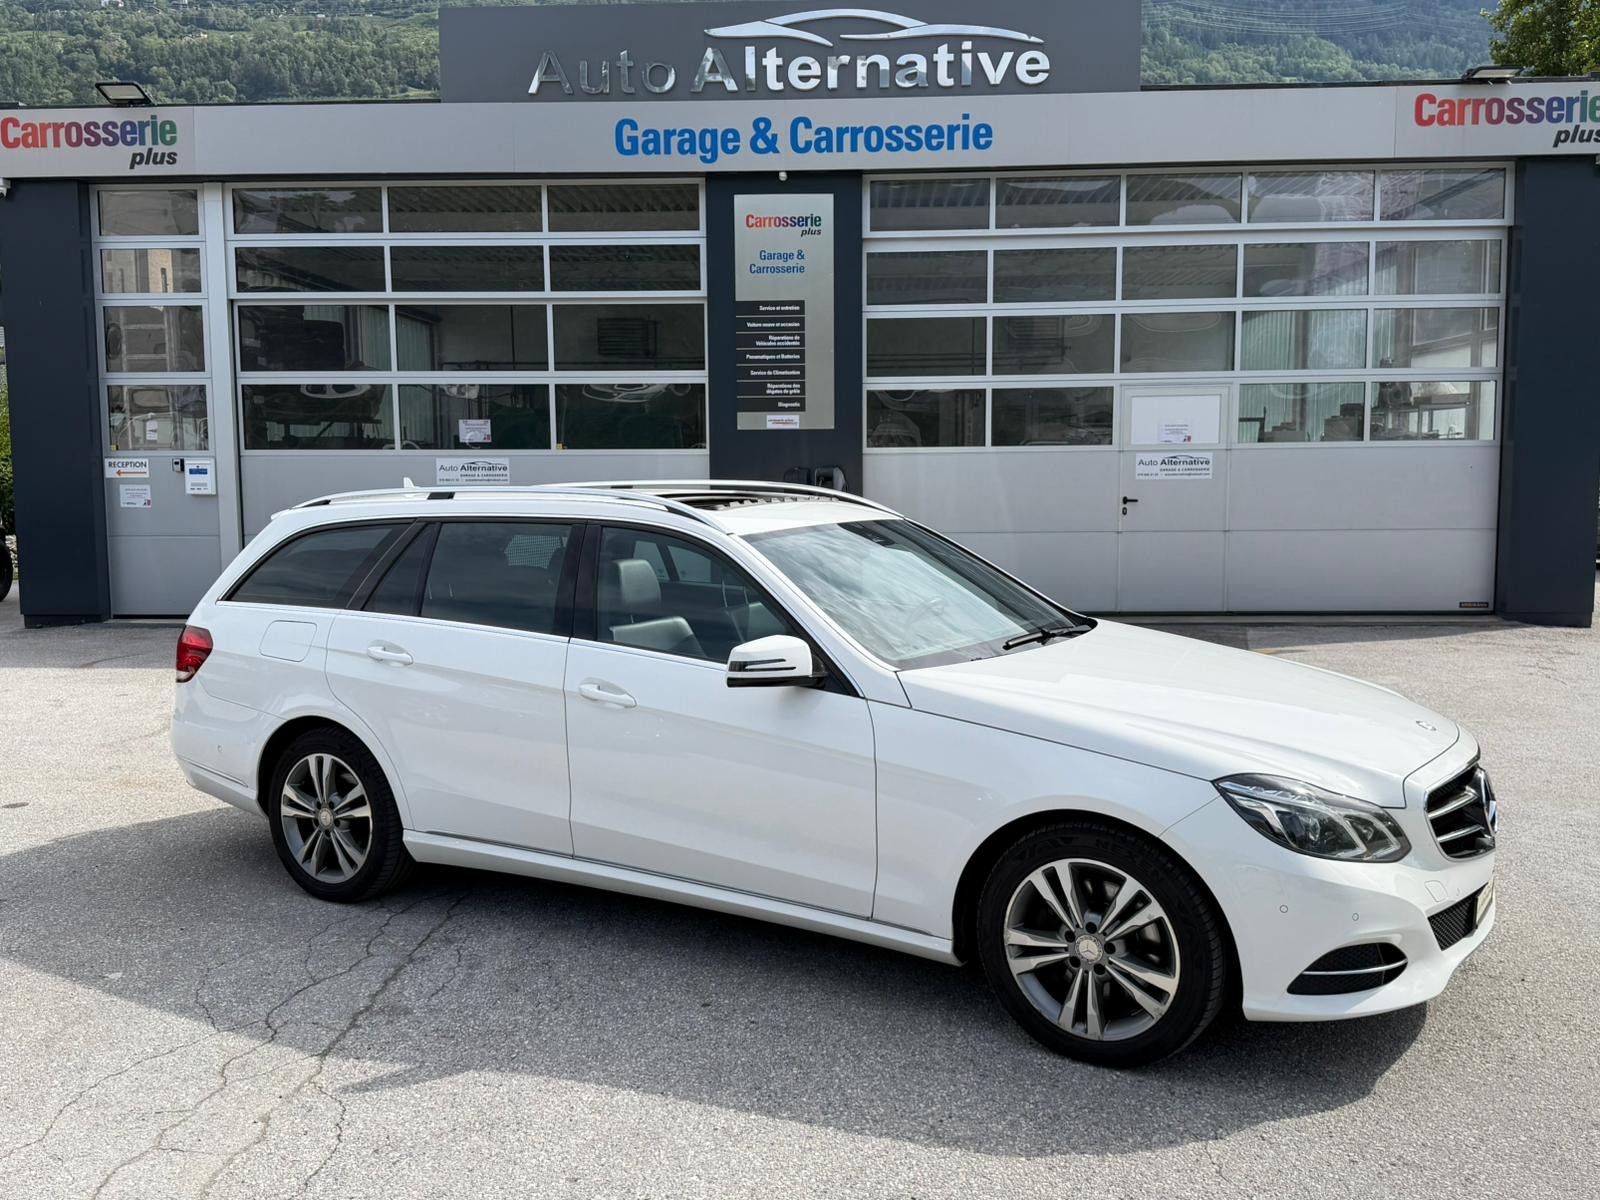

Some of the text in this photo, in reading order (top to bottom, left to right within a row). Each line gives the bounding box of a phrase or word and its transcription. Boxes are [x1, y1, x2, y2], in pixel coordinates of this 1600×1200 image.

[527, 40, 1051, 96] Auto Alternative
[1414, 90, 1600, 127] Carrosserie
[0, 115, 178, 149] Carrosserie
[614, 113, 993, 164] Garage & Carrosserie
[129, 148, 178, 169] plus
[746, 213, 822, 228] Carrosserie
[800, 228, 822, 238] plus
[759, 249, 805, 262] Garage &
[749, 263, 805, 274] Carrosserie
